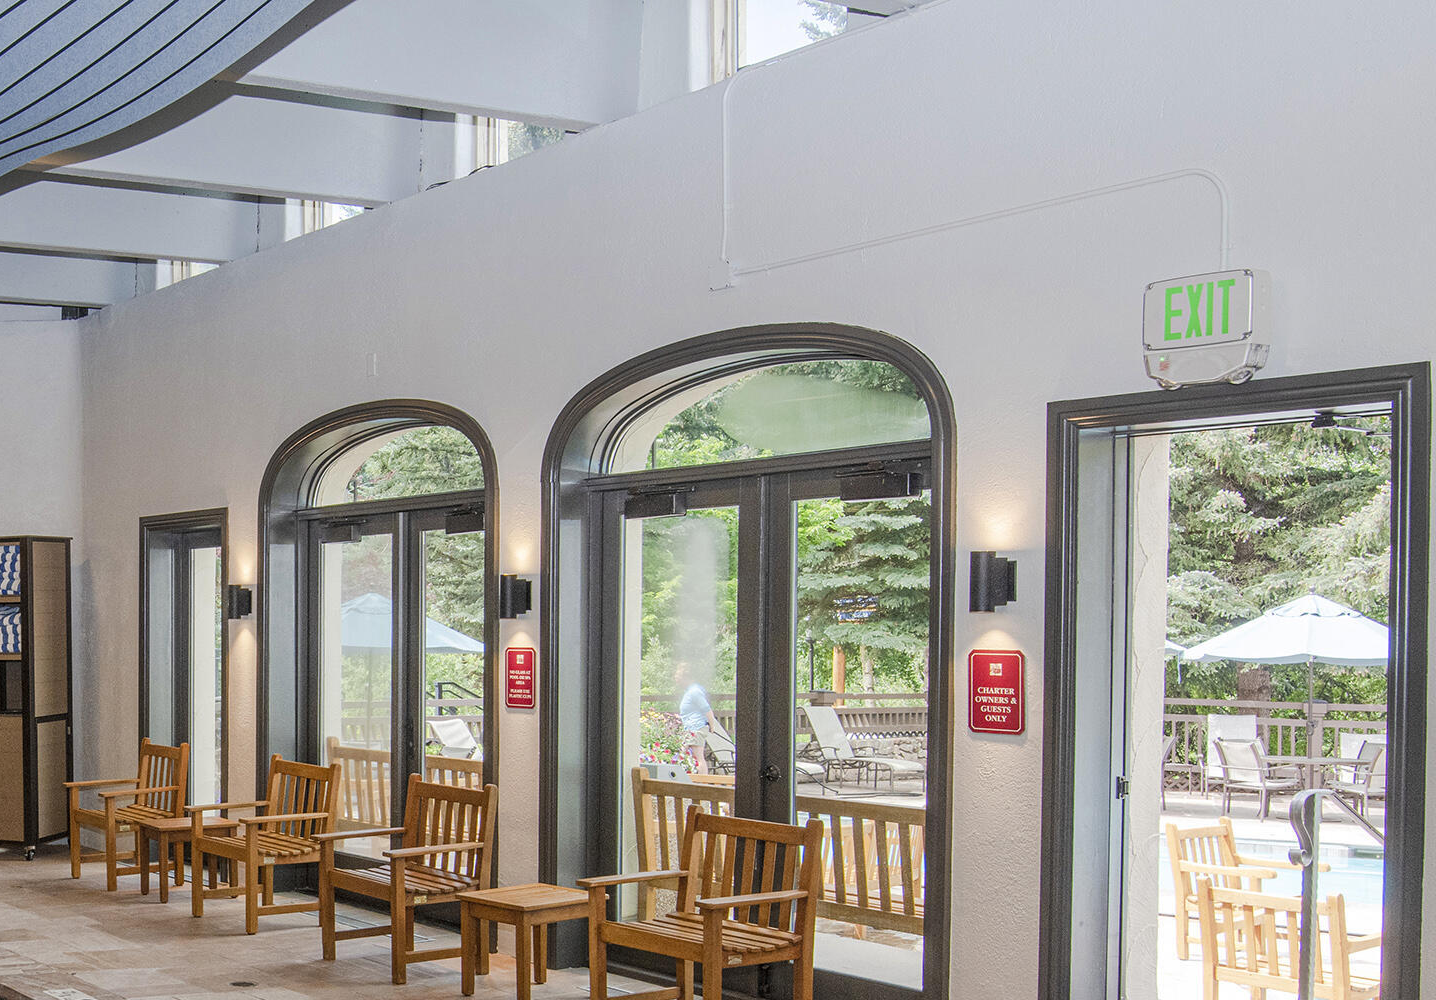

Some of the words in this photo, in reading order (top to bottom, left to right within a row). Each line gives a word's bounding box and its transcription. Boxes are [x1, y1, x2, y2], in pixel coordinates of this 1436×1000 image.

[1164, 279, 1236, 341] EXIT
[977, 687, 1015, 695] CHARTER
[975, 696, 1009, 704] OWNERS
[1010, 697, 1017, 705] &
[980, 705, 1011, 714] GUESTS
